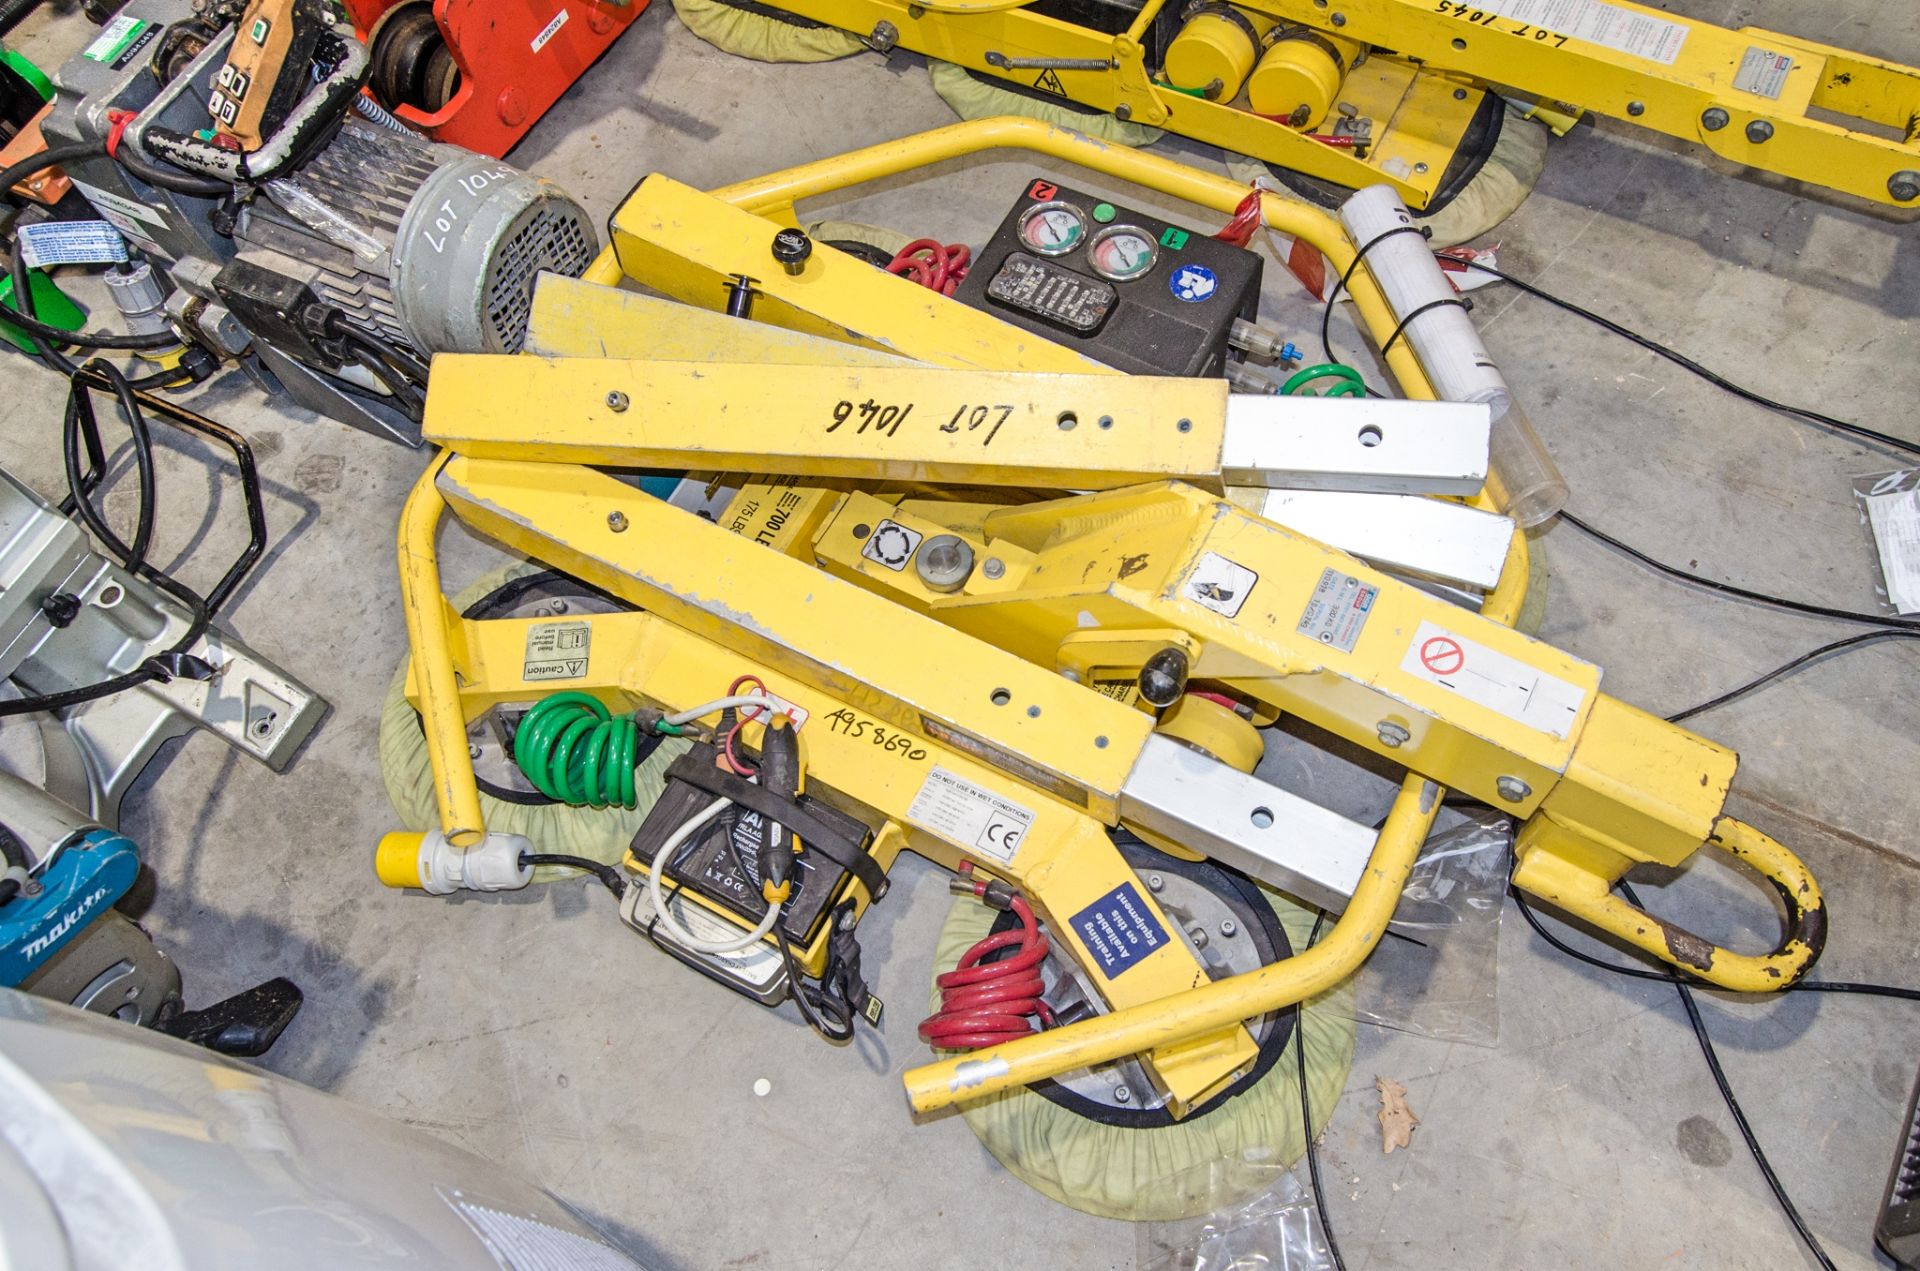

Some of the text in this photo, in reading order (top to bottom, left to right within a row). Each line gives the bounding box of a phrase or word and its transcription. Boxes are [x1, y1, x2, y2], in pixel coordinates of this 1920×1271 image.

[1435, 0, 1568, 48] LOT 1045
[423, 166, 519, 253] LOT 1049
[1035, 183, 1053, 199] 2
[826, 399, 1014, 446] LOT 1046
[741, 500, 760, 517] 175
[766, 508, 791, 532] 700
[527, 666, 564, 674] Caution
[823, 708, 927, 760] A958690
[932, 772, 1030, 821] DO NOT USE IN WET CONDITIONS
[987, 823, 1019, 850] CE
[1095, 912, 1131, 958] Available
[1111, 909, 1138, 945] on this
[1116, 892, 1158, 946] Equipment
[1084, 921, 1116, 966] Training
